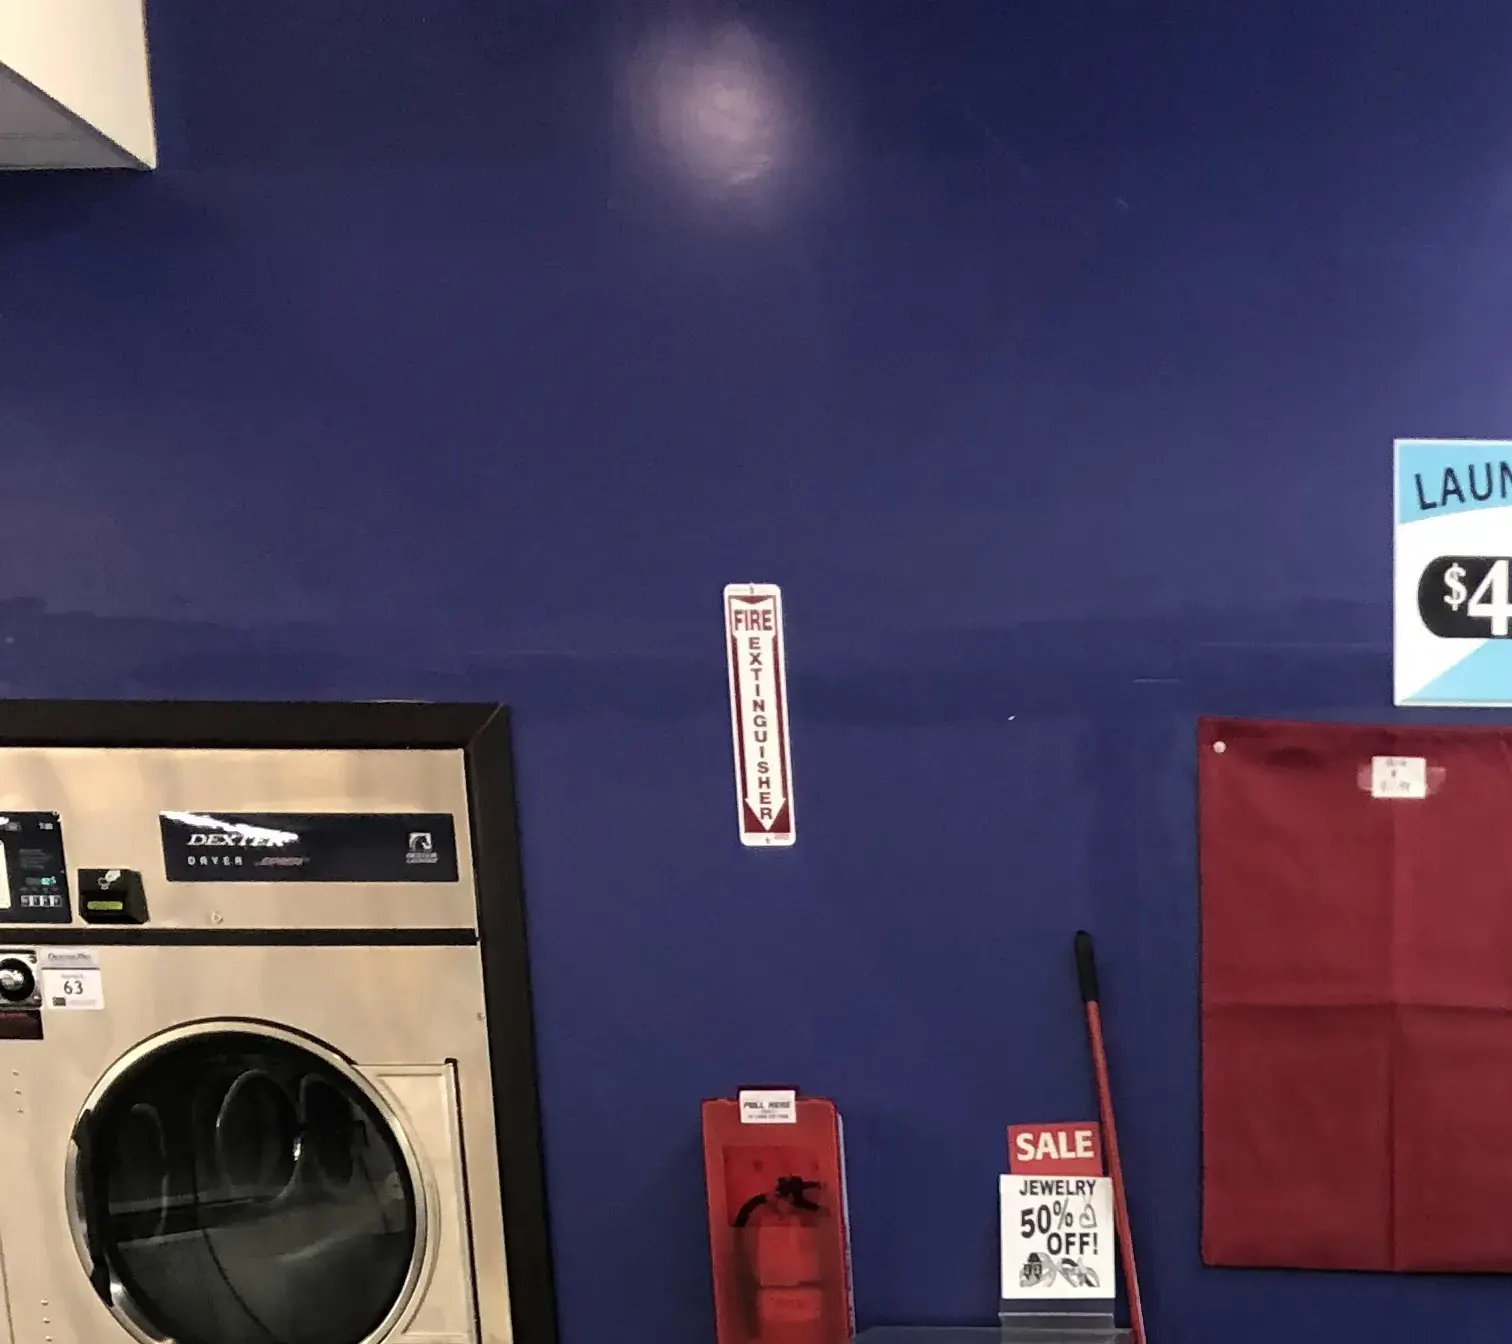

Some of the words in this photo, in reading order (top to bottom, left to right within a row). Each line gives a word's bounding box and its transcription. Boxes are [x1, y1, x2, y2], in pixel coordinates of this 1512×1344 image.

[734, 609, 773, 632] FIRE
[748, 636, 773, 821] EXTINGUISHER
[63, 980, 84, 996] 63
[1016, 1130, 1094, 1161] SALE
[1019, 1179, 1097, 1197] JEWELRY
[1020, 1197, 1074, 1239] 50%
[1047, 1232, 1099, 1256] OFF!
